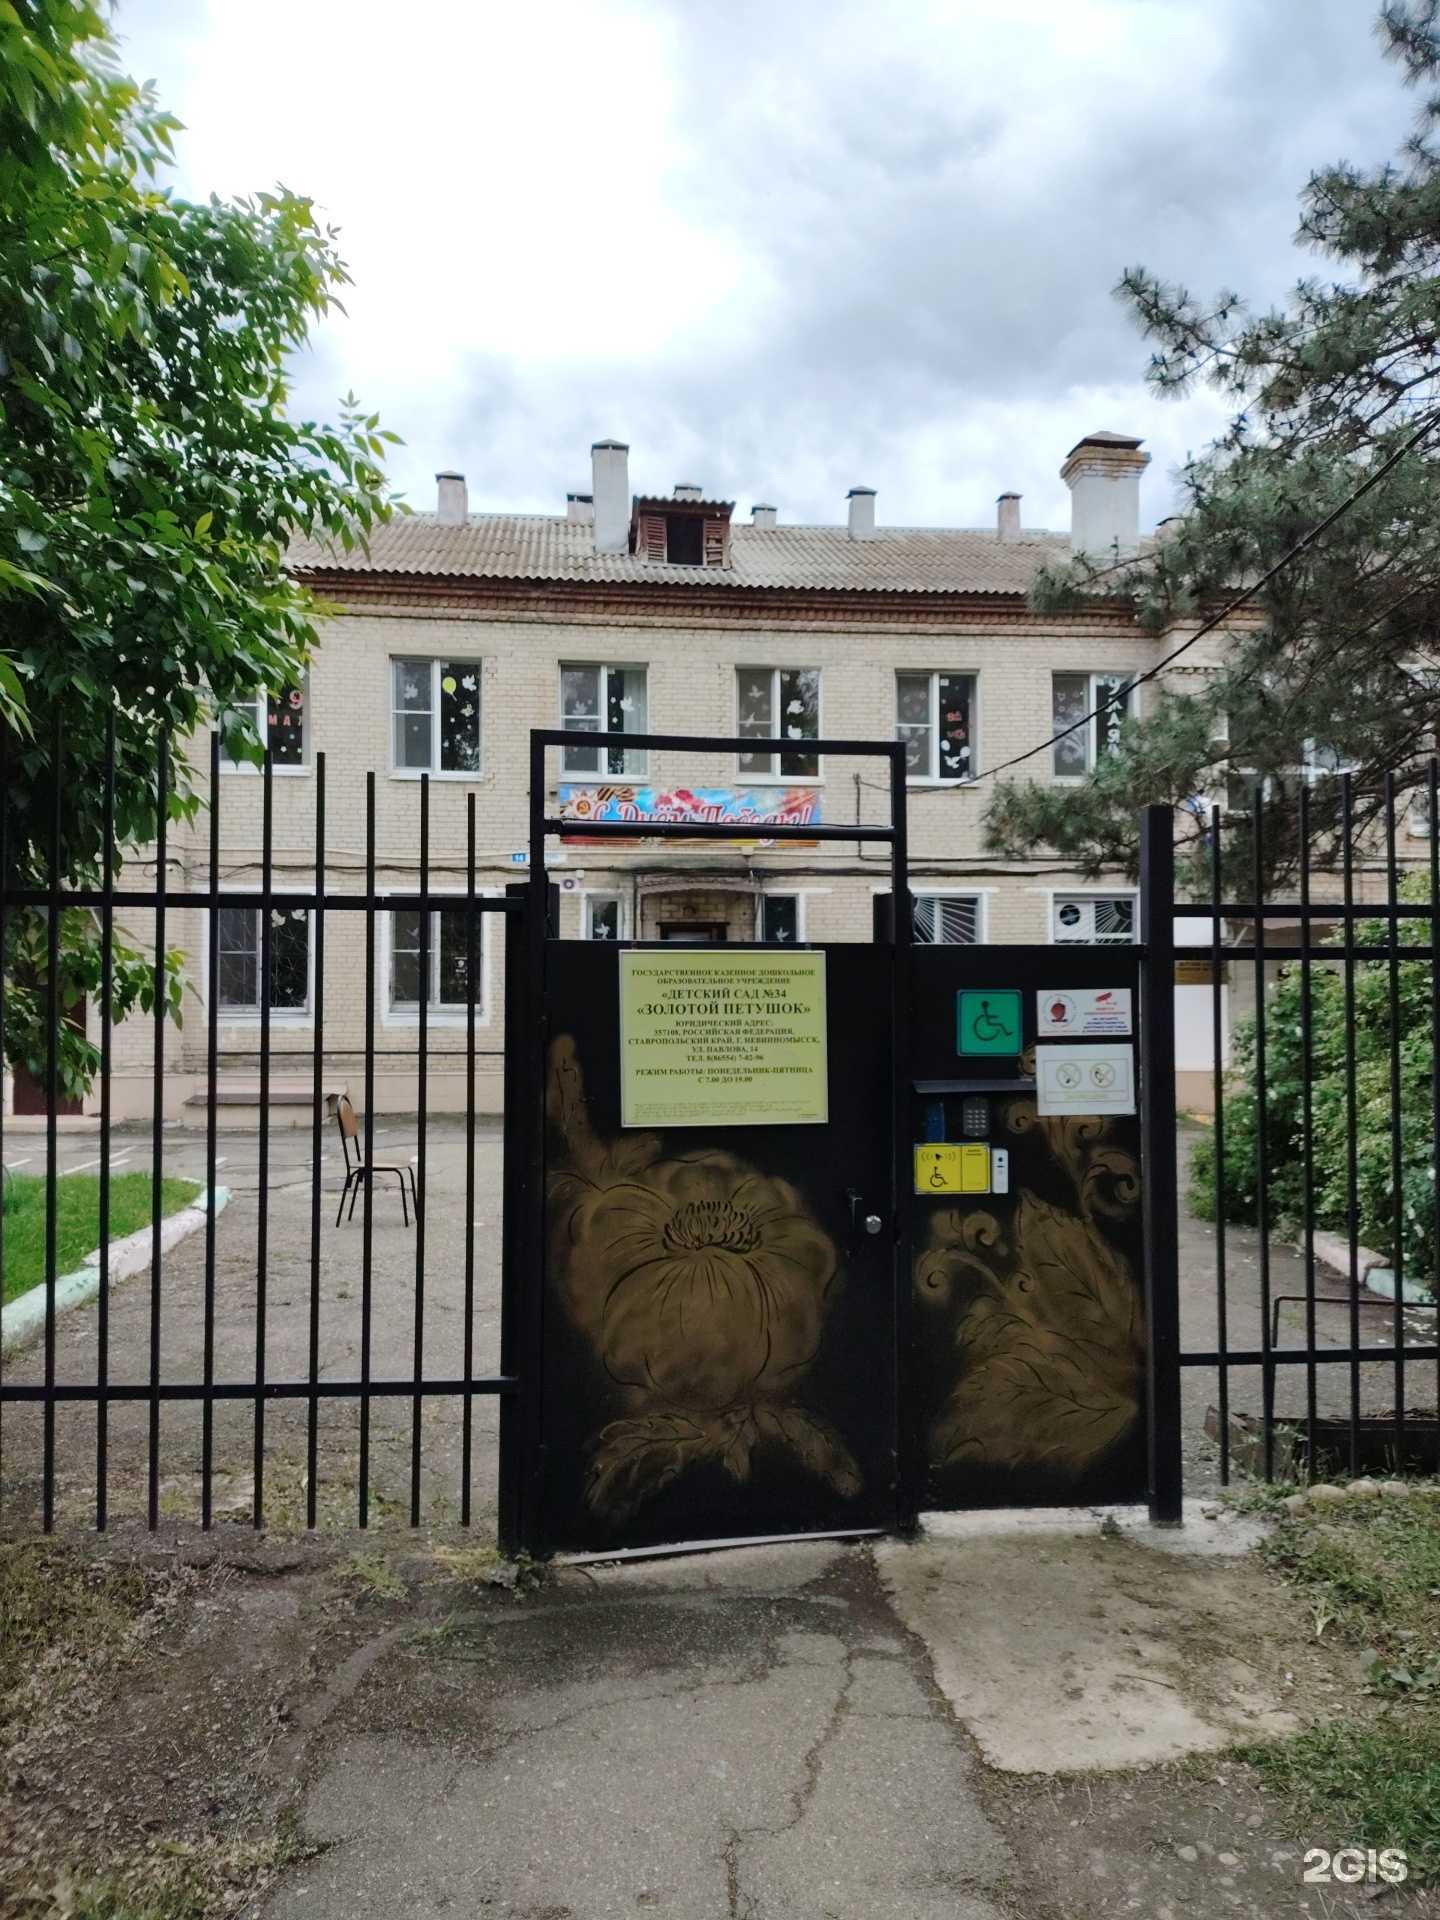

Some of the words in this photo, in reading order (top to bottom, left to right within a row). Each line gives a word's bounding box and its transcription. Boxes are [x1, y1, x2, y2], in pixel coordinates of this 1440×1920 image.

[289, 690, 303, 710] 9
[632, 968, 712, 977] ГОСУДАРСТВЕННОЕ
[758, 968, 816, 977] ДОШКОЛЬНОЕ
[656, 977, 735, 985] ОБРАЗОВАТЕЛЬНОЕ
[737, 977, 790, 985] УЧРЕЖДЕНИЕ
[661, 987, 730, 1000] «ДЕТСКИЙ
[733, 988, 760, 1000] САД
[762, 988, 787, 999] №34
[636, 1000, 719, 1016] «ЗОЛОТОЙ
[724, 1002, 811, 1015] ПЕТУШОК»
[675, 1019, 742, 1028] ЮРИДИЧЕСКИЙ
[682, 1028, 741, 1037] РОССИЙСКАЯ
[628, 1037, 709, 1046] СТАВРОПОЛЬСКИЙ
[635, 1068, 668, 1076] РЕЖИМ
